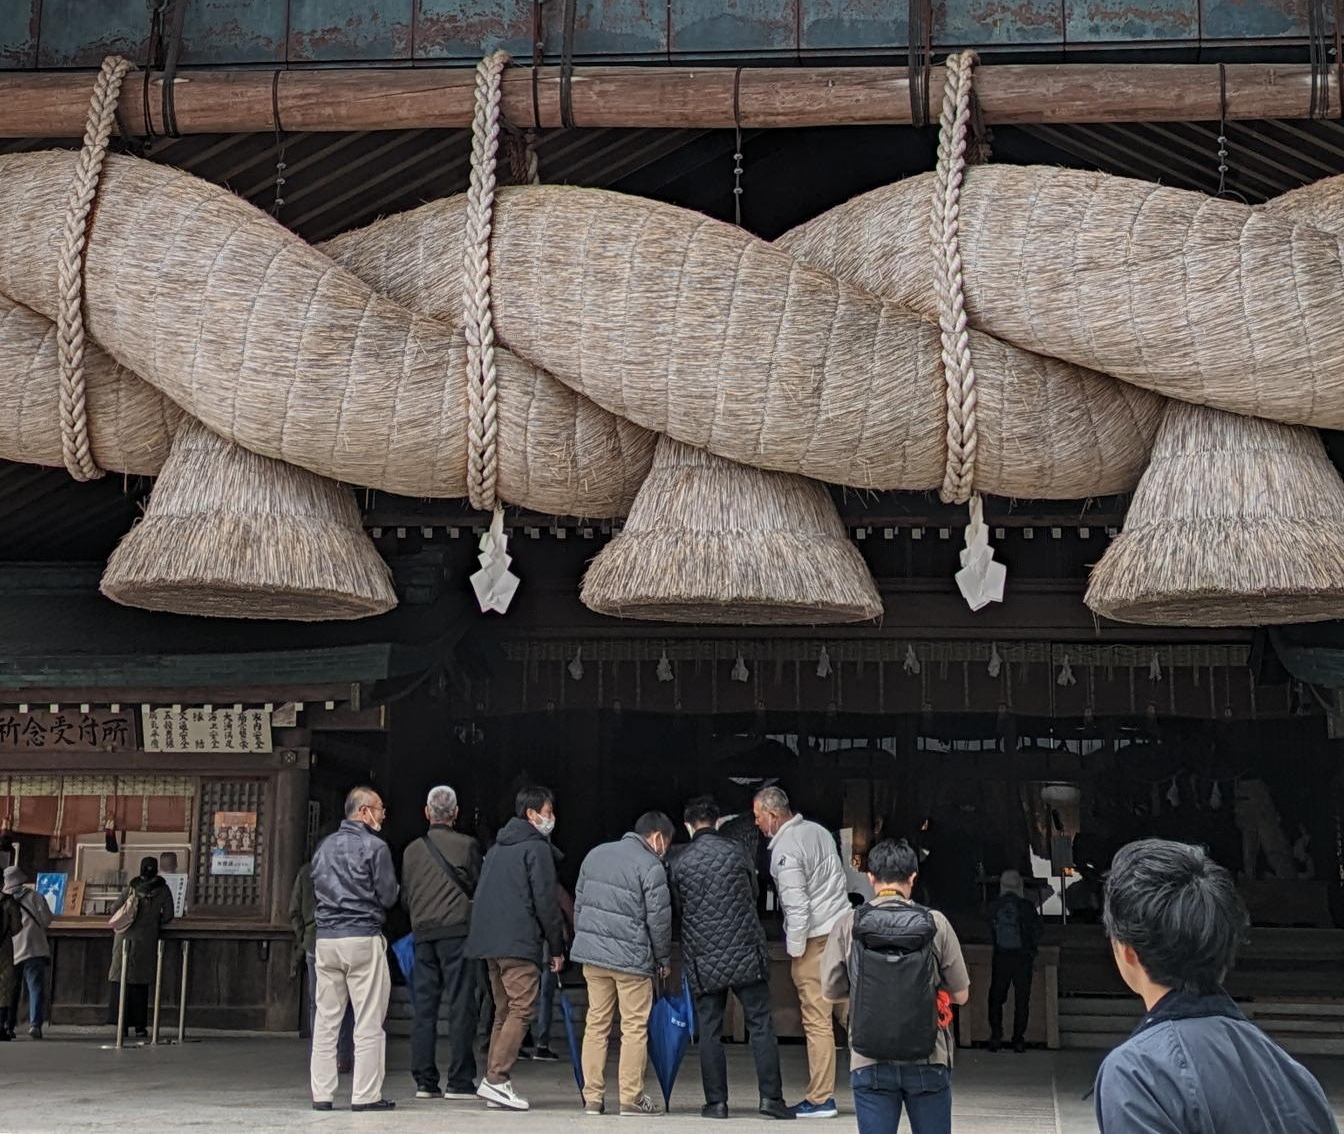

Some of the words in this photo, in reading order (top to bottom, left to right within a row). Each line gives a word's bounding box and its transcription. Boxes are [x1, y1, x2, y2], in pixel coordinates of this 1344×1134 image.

[178, 712, 190, 749] 交通安全
[208, 713, 220, 749] 海上安全
[223, 712, 234, 749] 大漁満足
[251, 712, 265, 749] 家内安全
